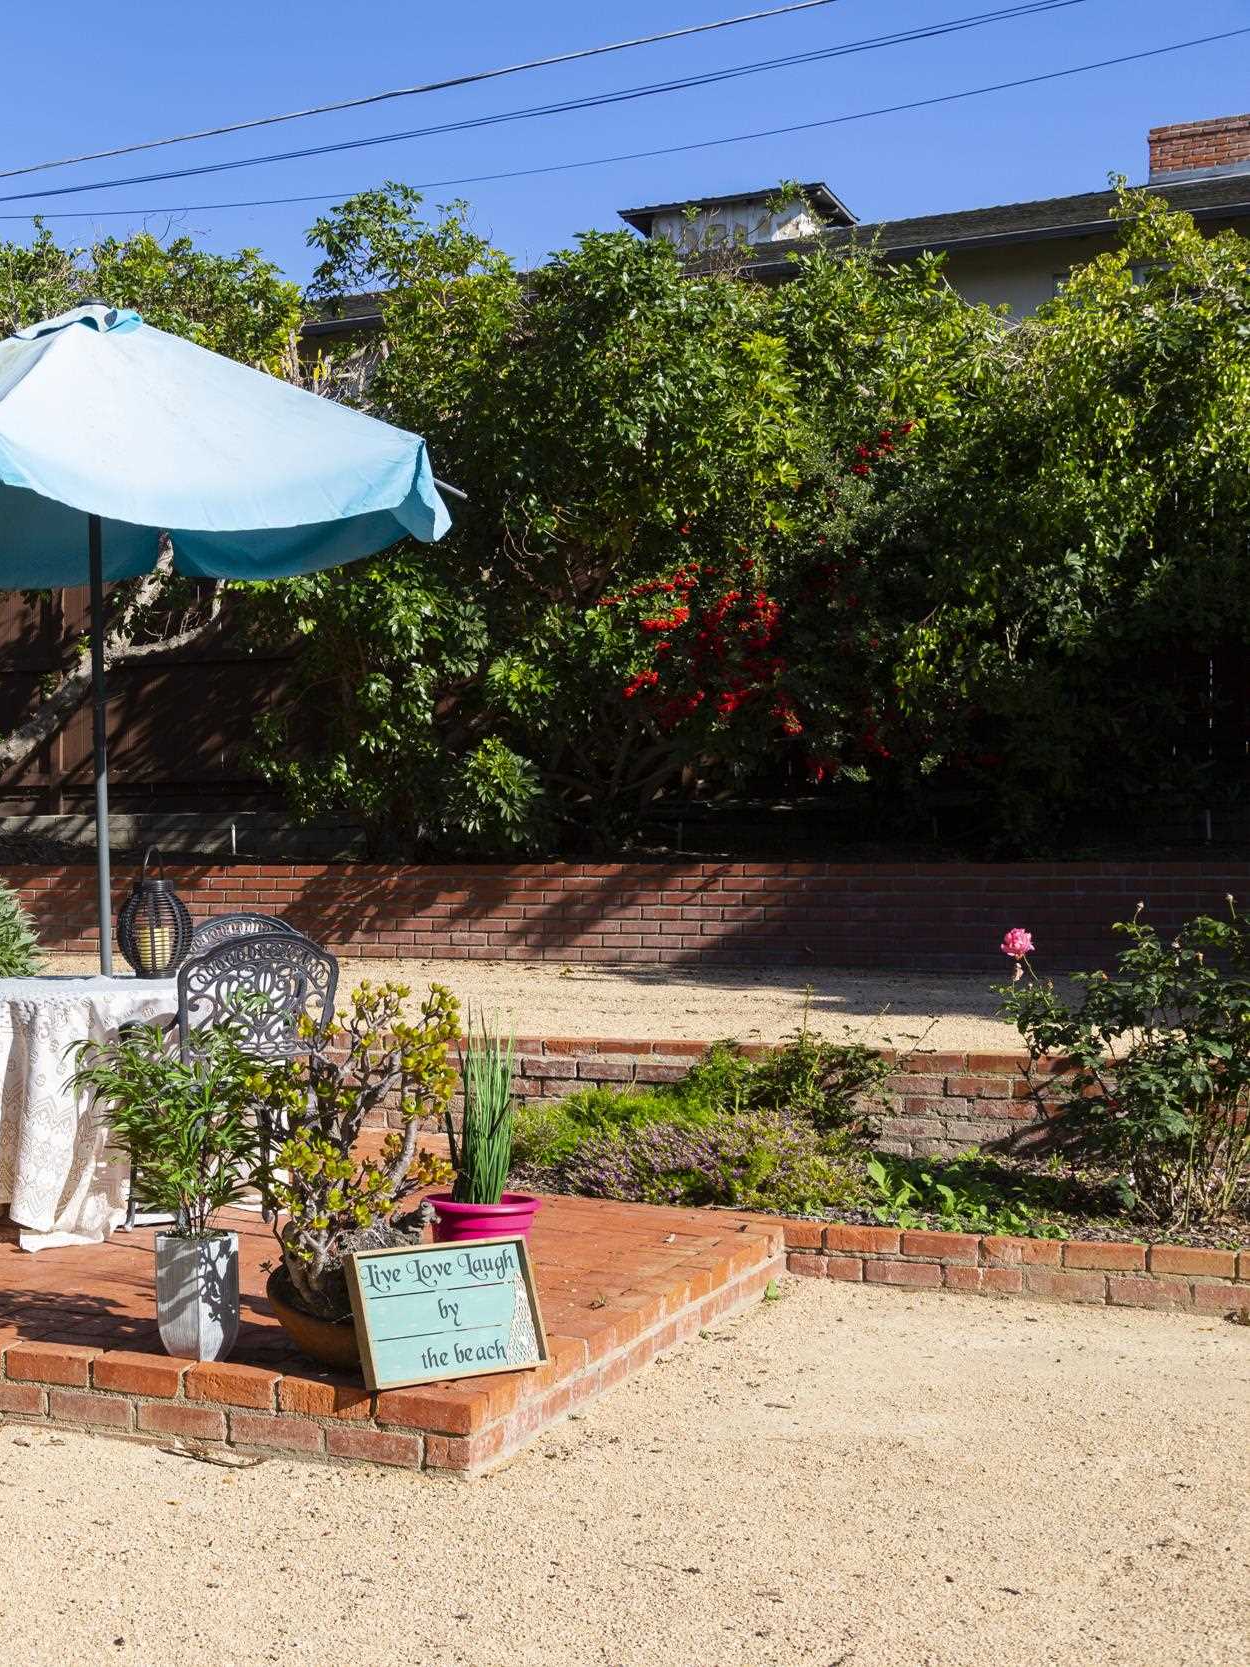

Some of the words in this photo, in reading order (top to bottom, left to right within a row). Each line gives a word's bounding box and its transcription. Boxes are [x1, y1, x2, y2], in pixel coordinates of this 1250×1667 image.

[360, 1263, 401, 1293] Live
[406, 1256, 452, 1287] Love
[457, 1249, 515, 1280] Laugh
[437, 1298, 462, 1326] by
[421, 1347, 449, 1369] the
[454, 1339, 508, 1364] beach
